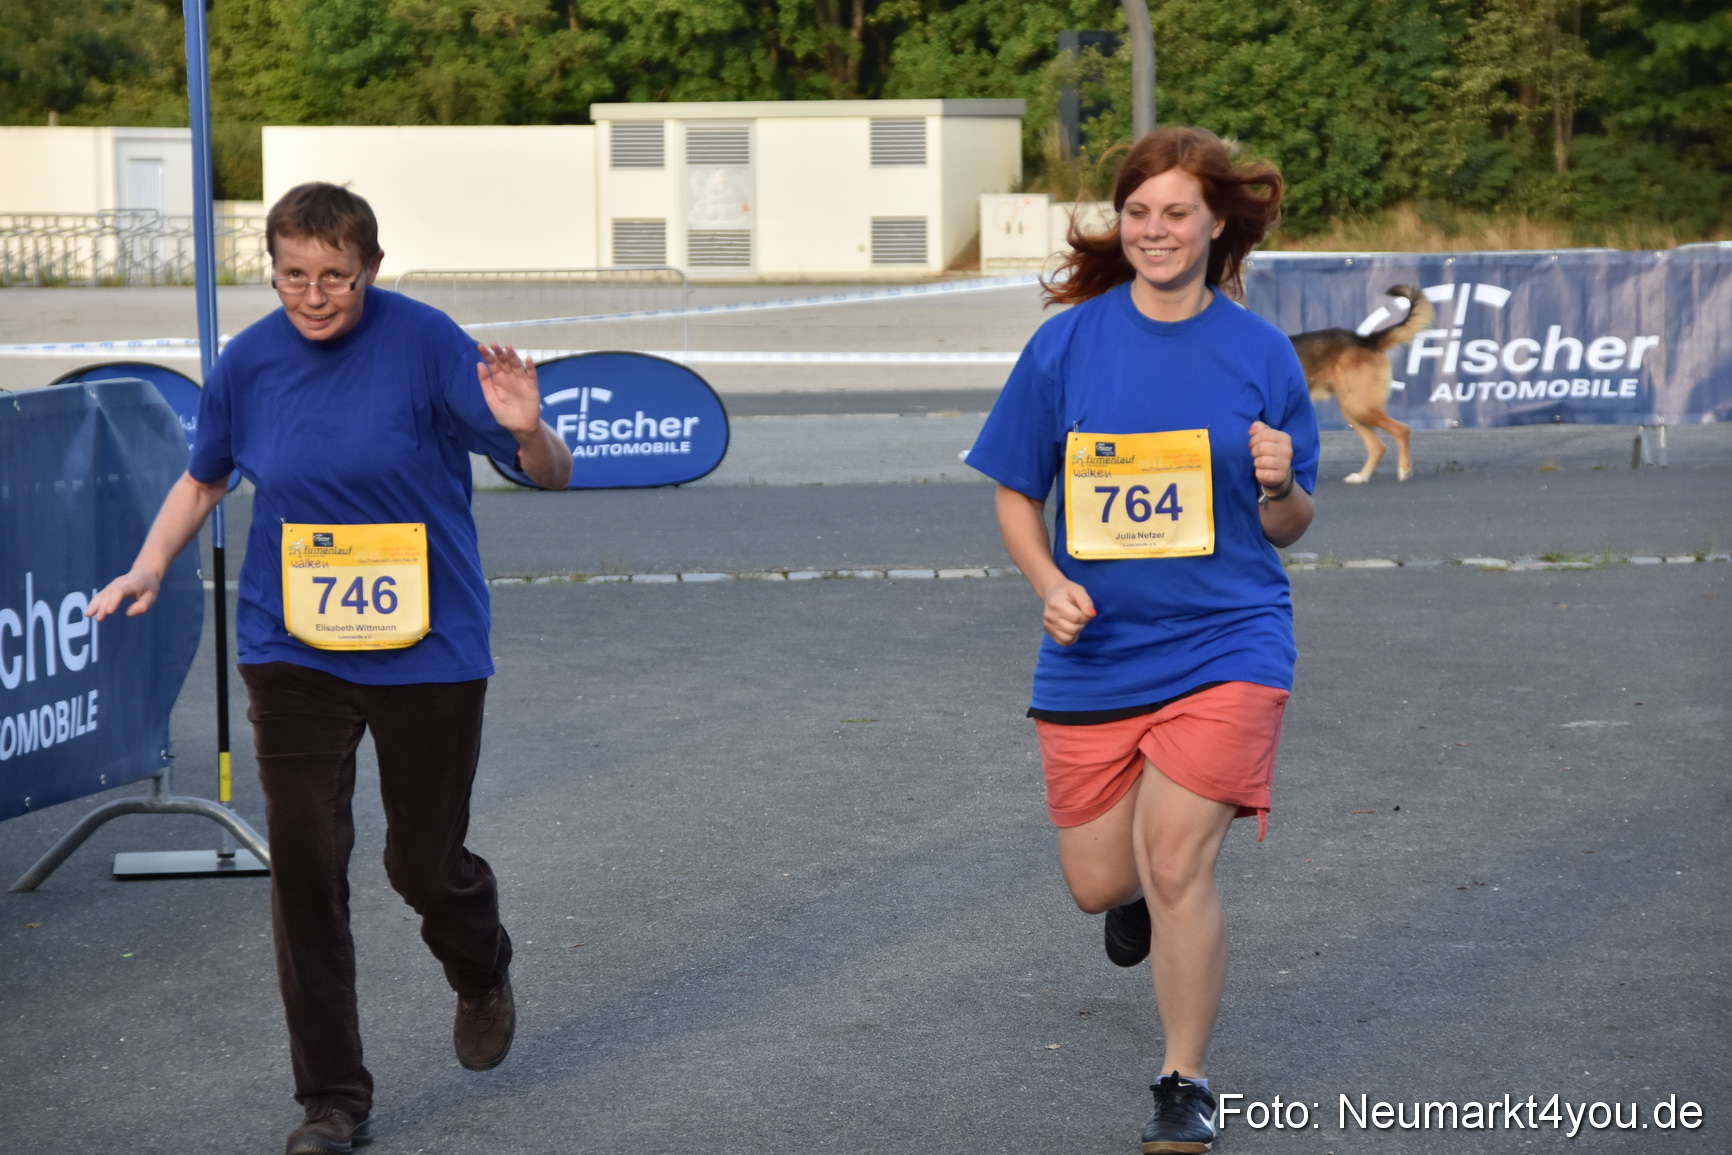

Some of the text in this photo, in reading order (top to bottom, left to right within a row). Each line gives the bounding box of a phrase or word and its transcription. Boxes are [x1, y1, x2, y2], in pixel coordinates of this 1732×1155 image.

[1406, 324, 1660, 376] Fischer
[1429, 378, 1639, 402] AUTOMOBILE
[556, 410, 699, 443] Fischer
[571, 441, 691, 458] AUTOMOBILE
[1086, 454, 1136, 464] firmenlauf
[1094, 482, 1184, 524] 764
[1115, 532, 1137, 541] Julia
[303, 545, 353, 555] firmenlauf
[312, 575, 399, 616] 746
[315, 624, 397, 632] Elisabeth Wittmann
